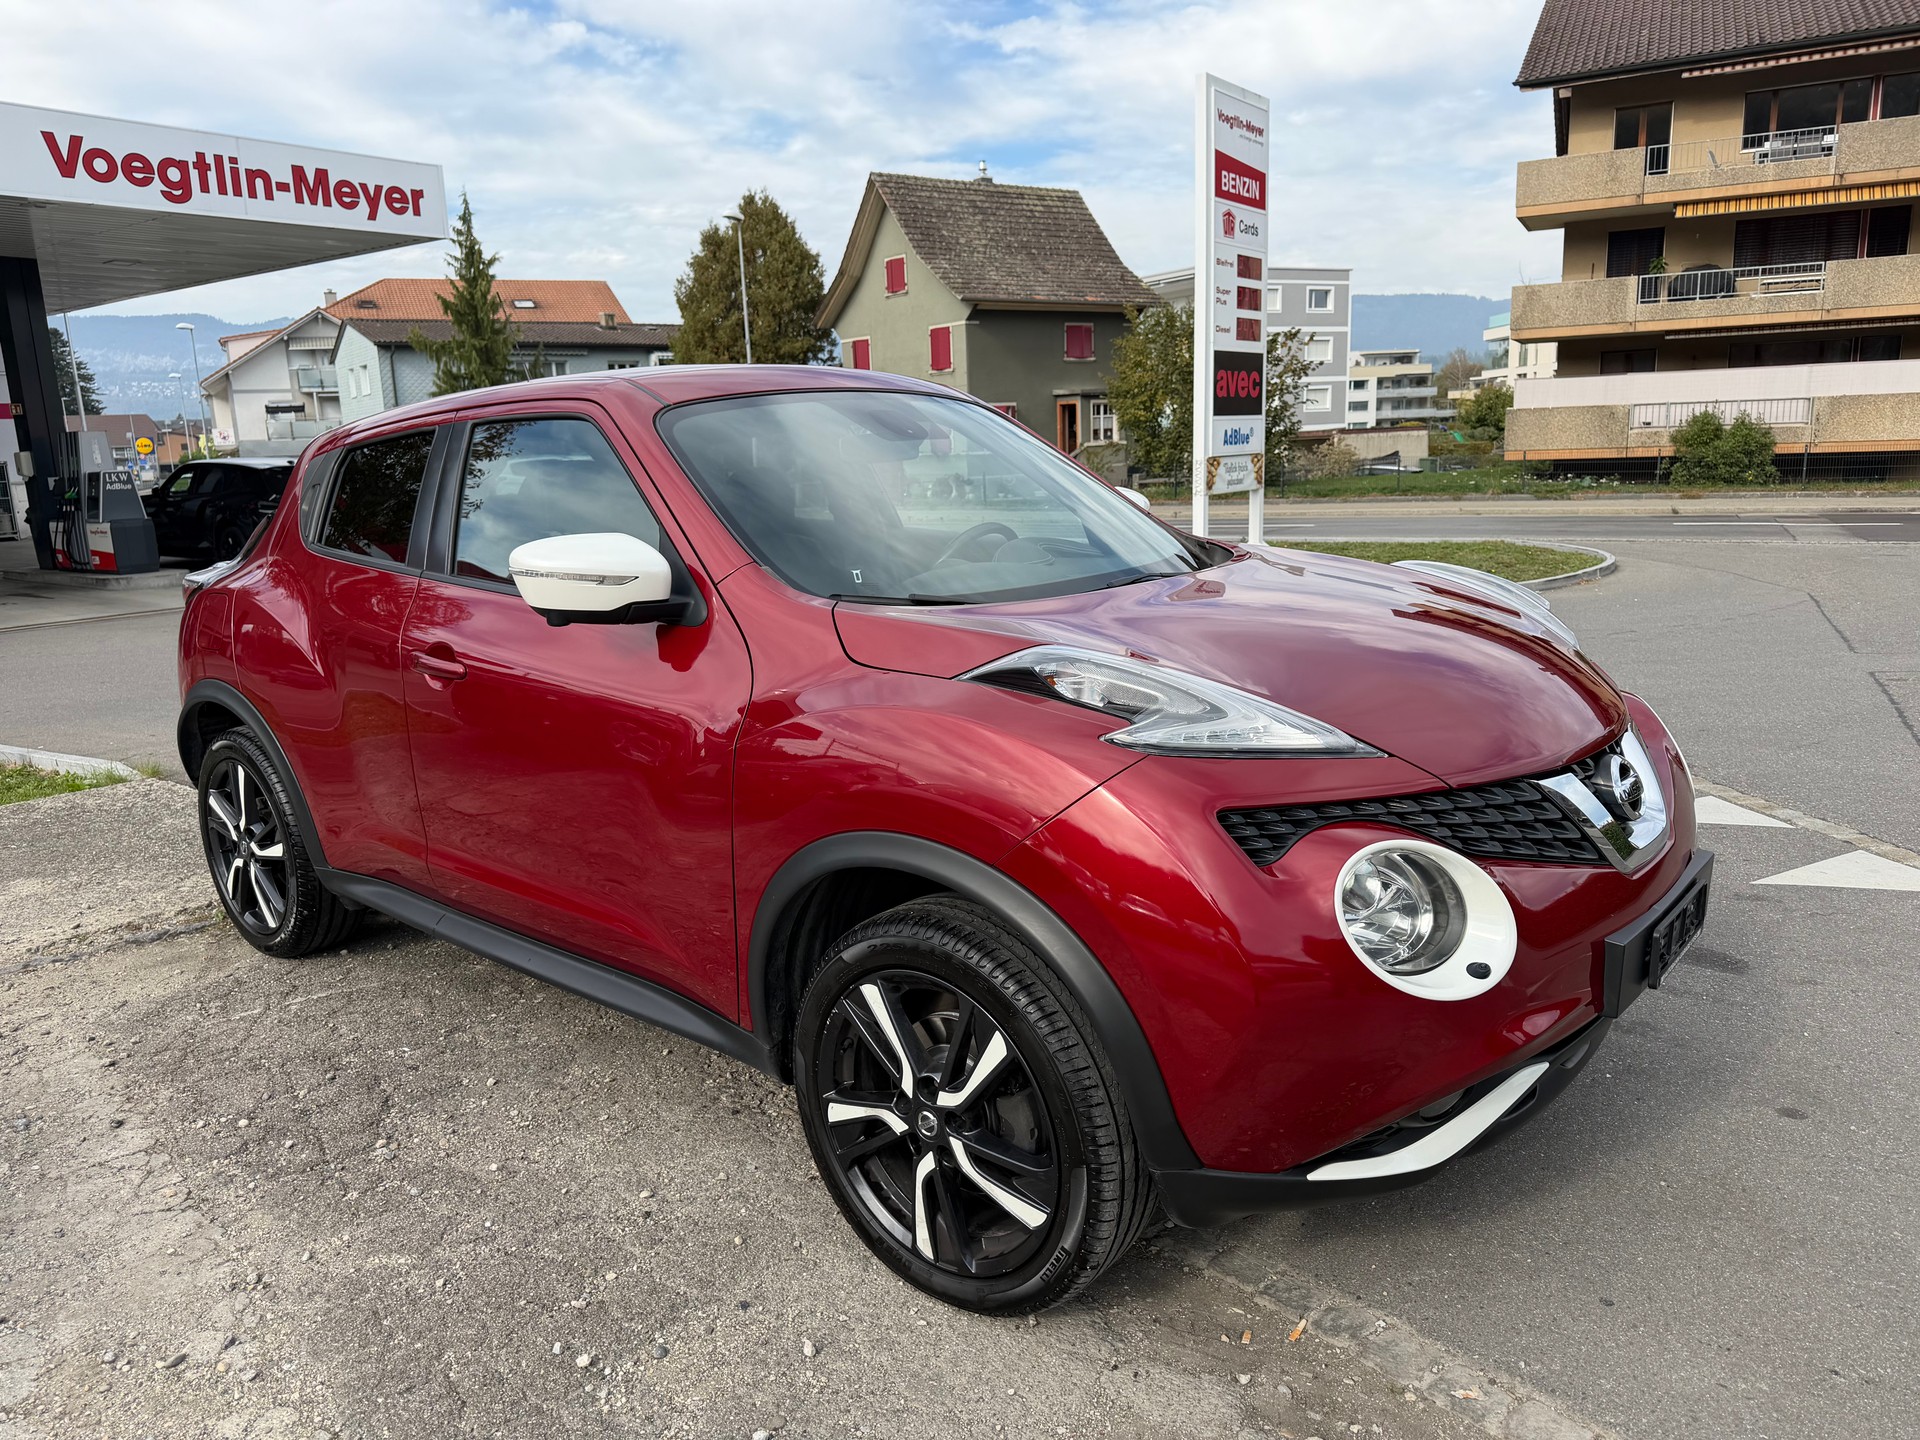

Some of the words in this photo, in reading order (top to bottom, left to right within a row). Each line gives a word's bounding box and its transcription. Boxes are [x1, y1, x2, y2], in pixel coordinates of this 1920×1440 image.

[1217, 108, 1264, 138] Voegtlin-Meyer
[40, 130, 424, 221] Voegtlin-Meyer
[1221, 169, 1260, 201] BENZIN
[1239, 219, 1259, 237] Cards
[1216, 286, 1231, 296] Super
[1216, 297, 1227, 306] Plus
[1215, 325, 1231, 334] Diesel
[1216, 369, 1260, 398] avec
[105, 472, 129, 482] LKW
[106, 482, 132, 490] AdBlue
